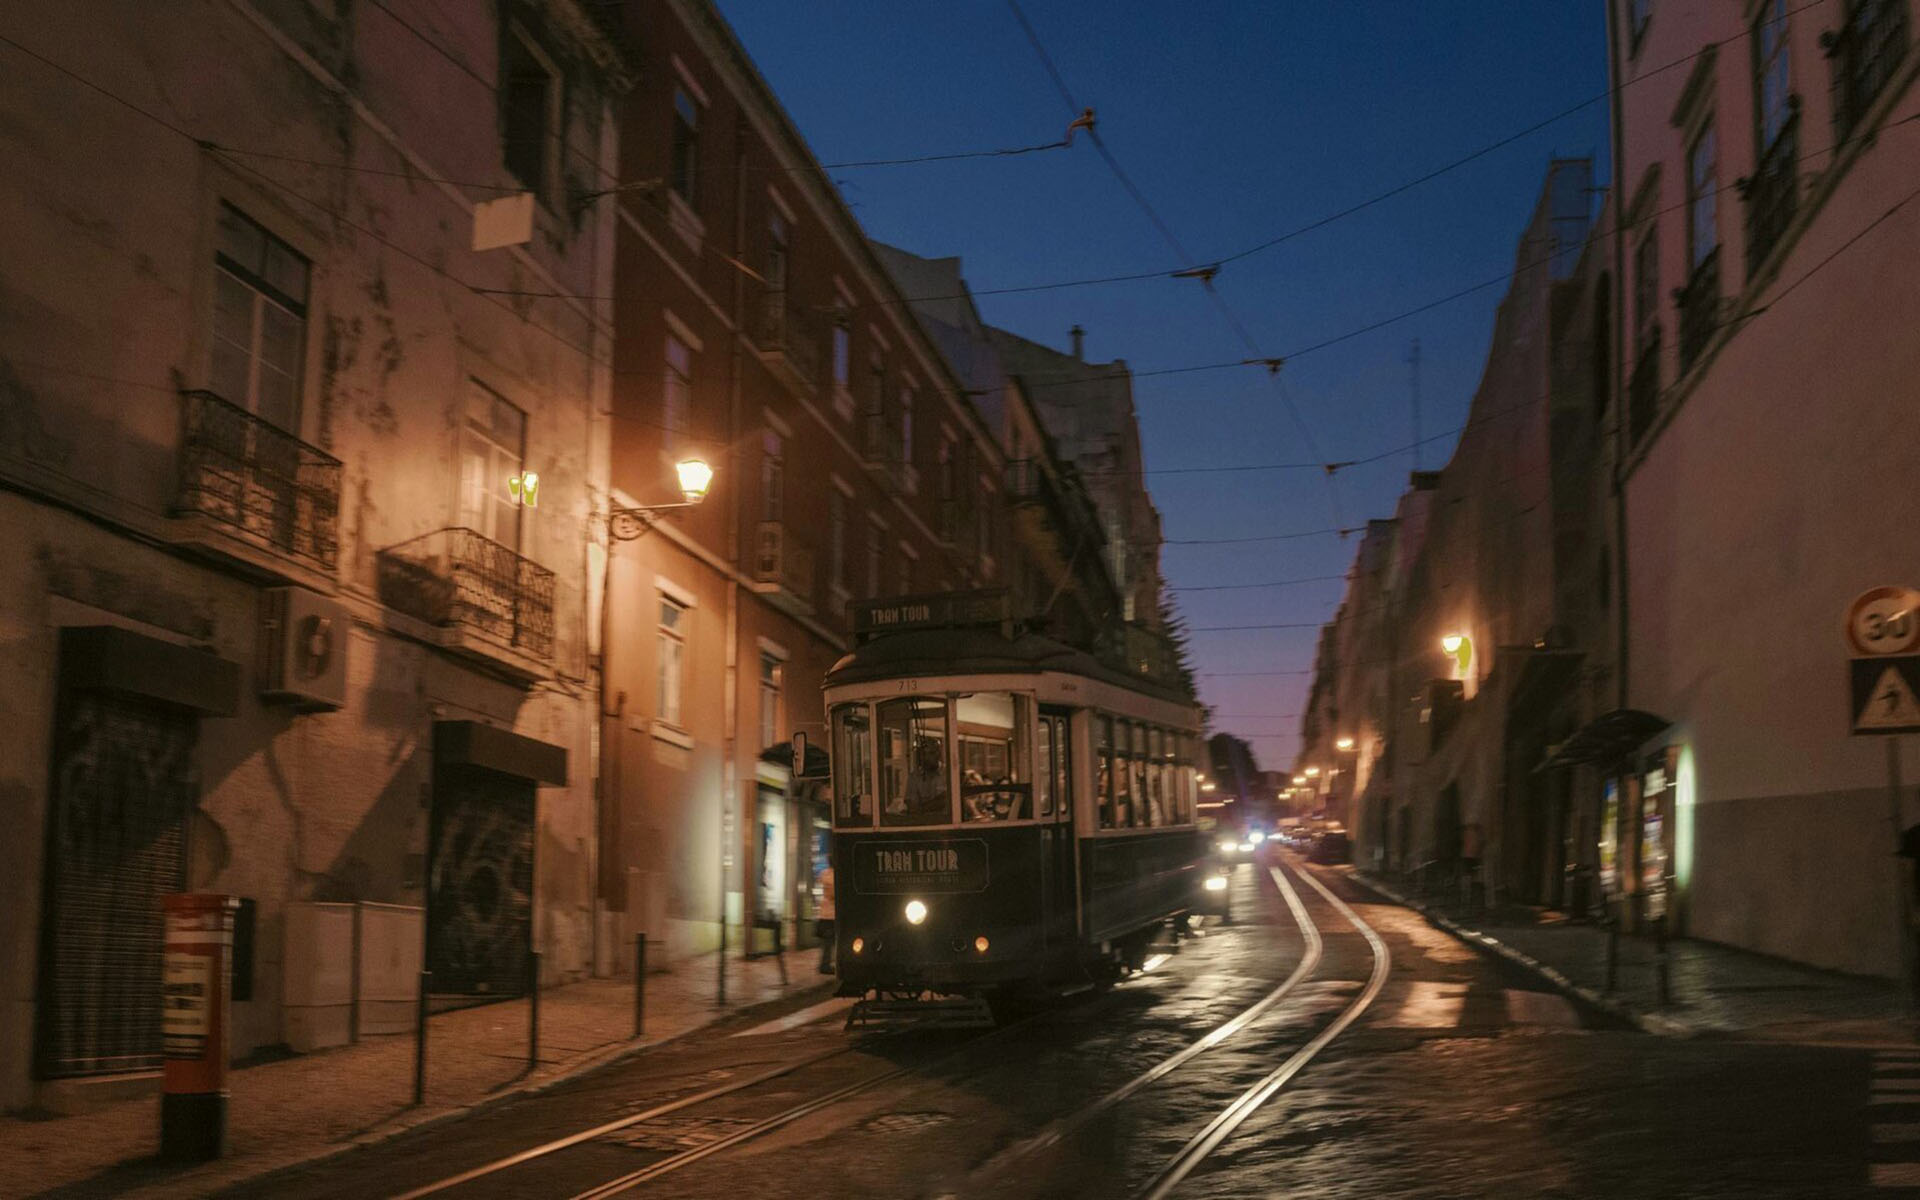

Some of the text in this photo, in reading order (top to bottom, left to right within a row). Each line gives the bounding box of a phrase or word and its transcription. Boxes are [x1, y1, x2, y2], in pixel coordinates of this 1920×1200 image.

[871, 604, 930, 625] TRAM TOUR
[1866, 612, 1911, 641] 30
[875, 849, 959, 873] TRAM TOUR
